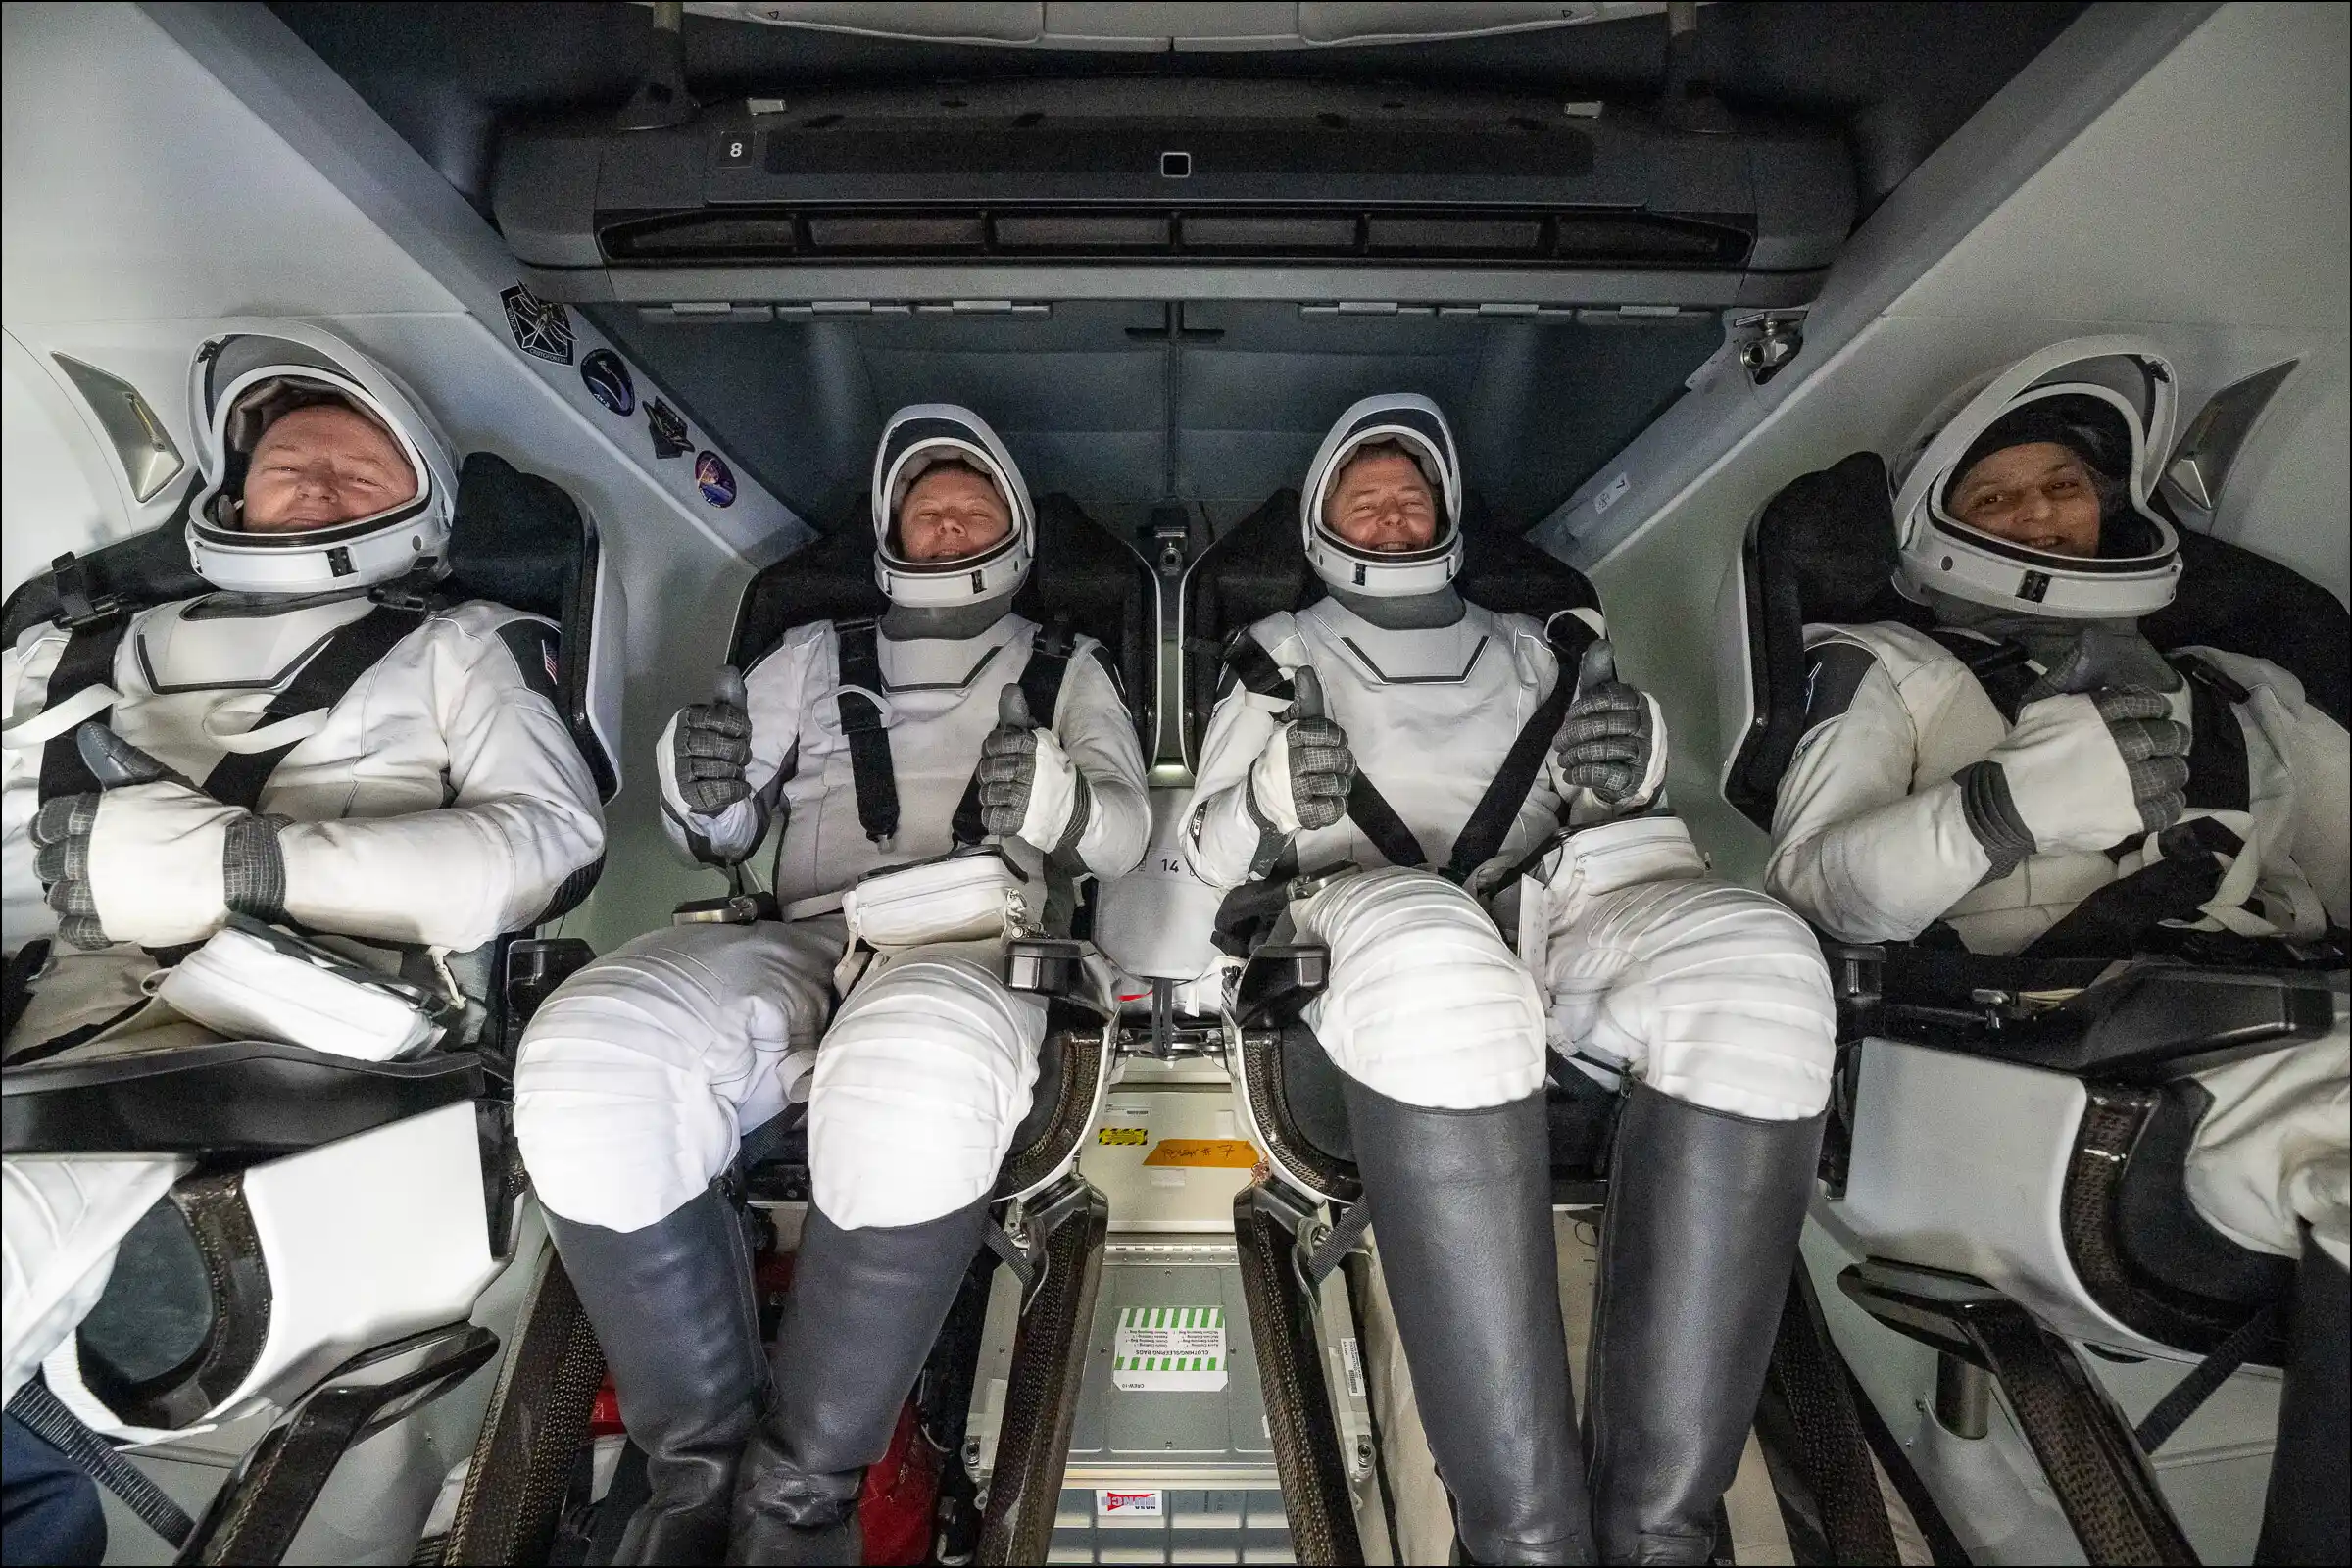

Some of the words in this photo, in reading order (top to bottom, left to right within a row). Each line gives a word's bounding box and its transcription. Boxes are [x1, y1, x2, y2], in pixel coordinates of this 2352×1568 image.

[730, 142, 743, 158] 8
[1161, 858, 1179, 874] 14
[1217, 1144, 1235, 1157] 7
